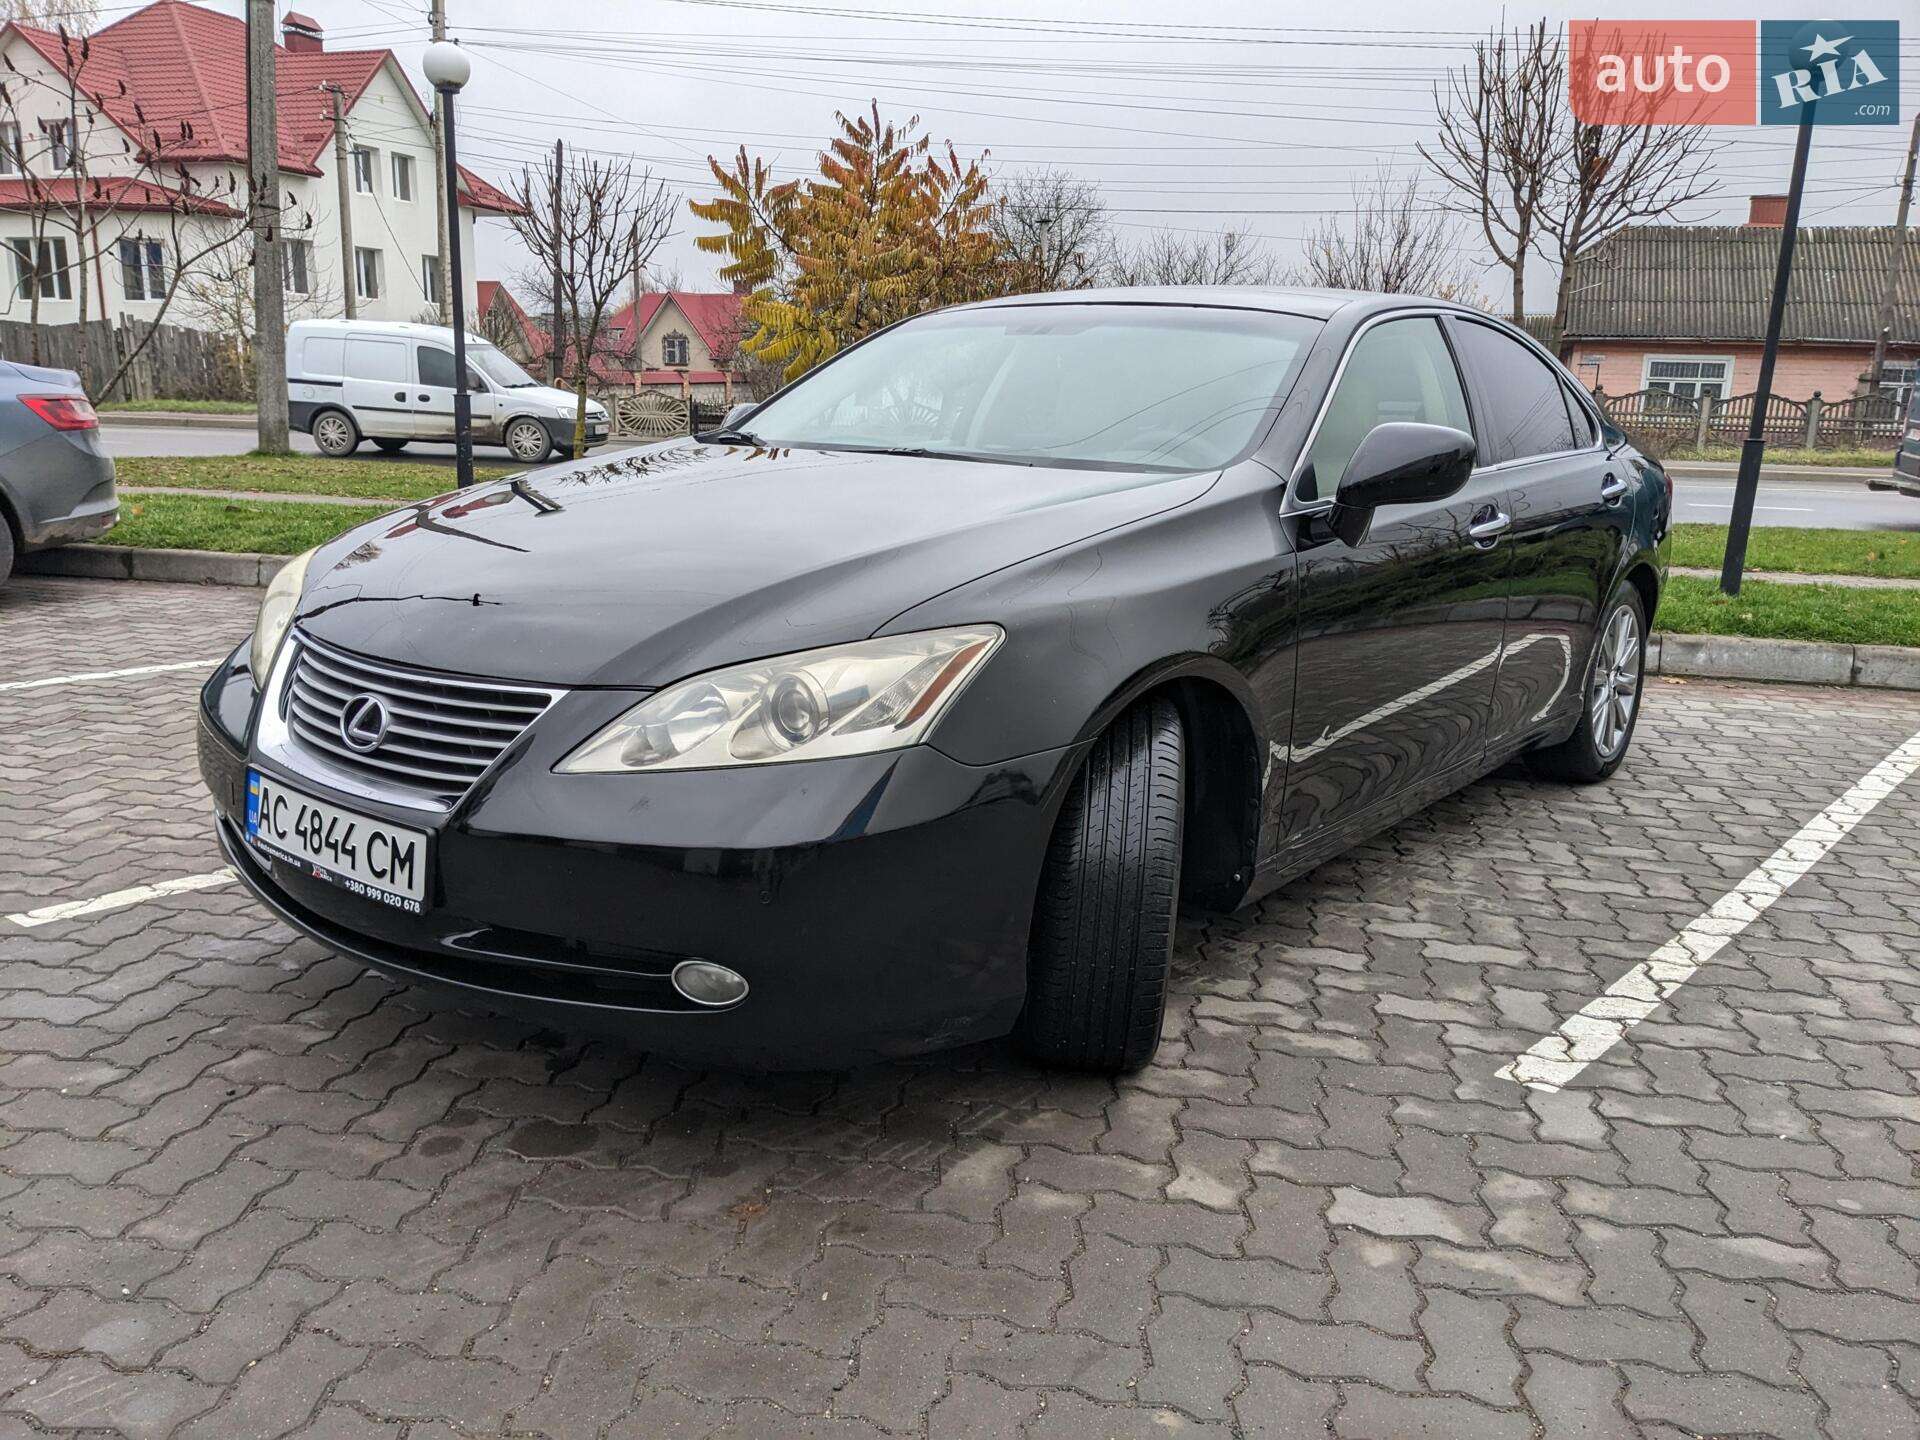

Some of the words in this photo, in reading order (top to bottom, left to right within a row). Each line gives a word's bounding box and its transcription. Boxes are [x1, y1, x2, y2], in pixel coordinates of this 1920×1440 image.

[248, 808, 258, 826] UA
[259, 786, 288, 840] AC
[295, 804, 356, 870] 4844
[366, 830, 415, 890] CM
[344, 879, 365, 895] +380
[366, 886, 382, 901] 999
[383, 892, 402, 907] 020
[403, 901, 421, 913] 678
